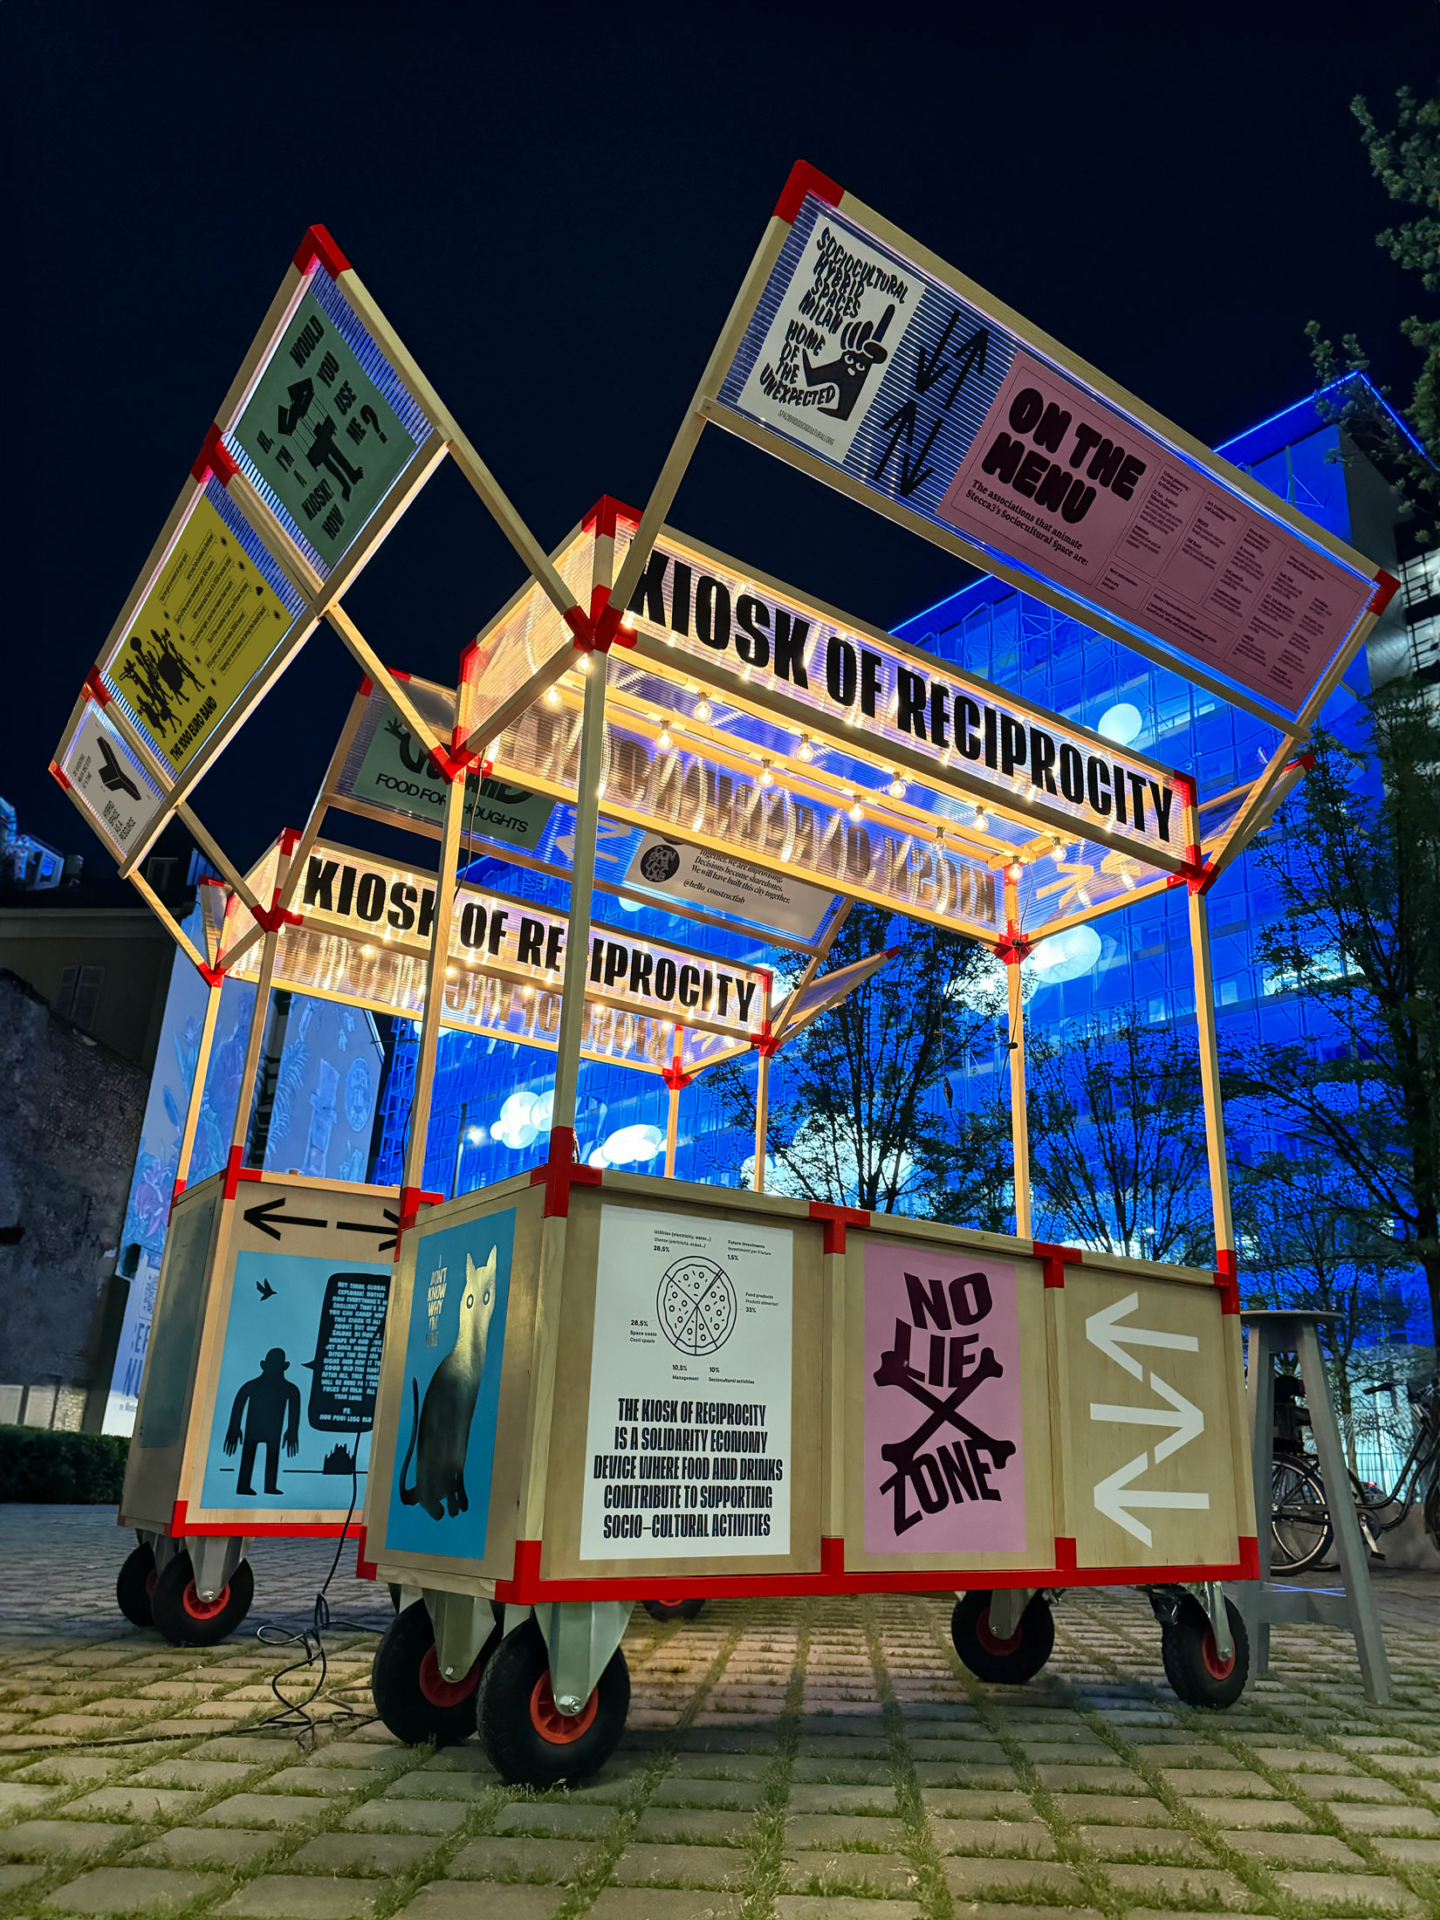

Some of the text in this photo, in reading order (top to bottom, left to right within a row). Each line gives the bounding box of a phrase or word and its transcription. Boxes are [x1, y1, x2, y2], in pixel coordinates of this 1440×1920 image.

[813, 250, 864, 298] HYBRID
[817, 227, 909, 304] SOCIOCULTURAL
[798, 290, 843, 334] MILAN
[812, 277, 861, 319] SPACES
[289, 315, 325, 369] WOULD
[781, 342, 800, 365] OF
[785, 320, 826, 356] HOME
[317, 351, 340, 388] YOU
[759, 363, 836, 407] UNEXPECTED
[776, 360, 800, 384] THE
[333, 380, 357, 416] USE
[256, 430, 274, 454] HI,
[275, 444, 294, 473] I'M
[1009, 387, 1147, 501] ON THE
[293, 469, 307, 488] A
[982, 432, 1096, 524] MENU
[301, 479, 334, 521] KIOSK!
[971, 480, 1082, 550] The associations that animate
[322, 504, 345, 540] HOW
[966, 490, 1089, 565] Stecca3's Sociocultural Space are:
[628, 546, 811, 690] KIOSK
[826, 636, 883, 719] OF
[896, 664, 1174, 843] RECIPROCITY
[169, 694, 218, 762] THE 1000 EURO BAND
[376, 773, 419, 796] FOOD
[463, 803, 528, 833] HOUGHTS
[692, 865, 790, 904] We will have built this city together.
[695, 858, 724, 871] Decisions
[725, 867, 749, 880] become
[737, 862, 749, 870] are
[461, 903, 508, 951] OF
[517, 919, 757, 1023] REIPROCITY
[427, 1283, 447, 1301] KNOW
[430, 1267, 447, 1285] DON'T
[428, 1299, 443, 1316] WHY
[904, 1272, 992, 1331] NO
[895, 1317, 979, 1388] LIE
[618, 1398, 766, 1426] THE KIOSK OF RECIPROCITY
[615, 1426, 768, 1454] IS A SOLIDARITY ECONOMY
[594, 1455, 783, 1481] DEVICE WHERE FOOD AND DRINKS
[604, 1484, 772, 1509] CONTRIBUTE TO SUPPORTING
[879, 1439, 1002, 1537] ZONE
[712, 1514, 770, 1537] ACTIVITIES
